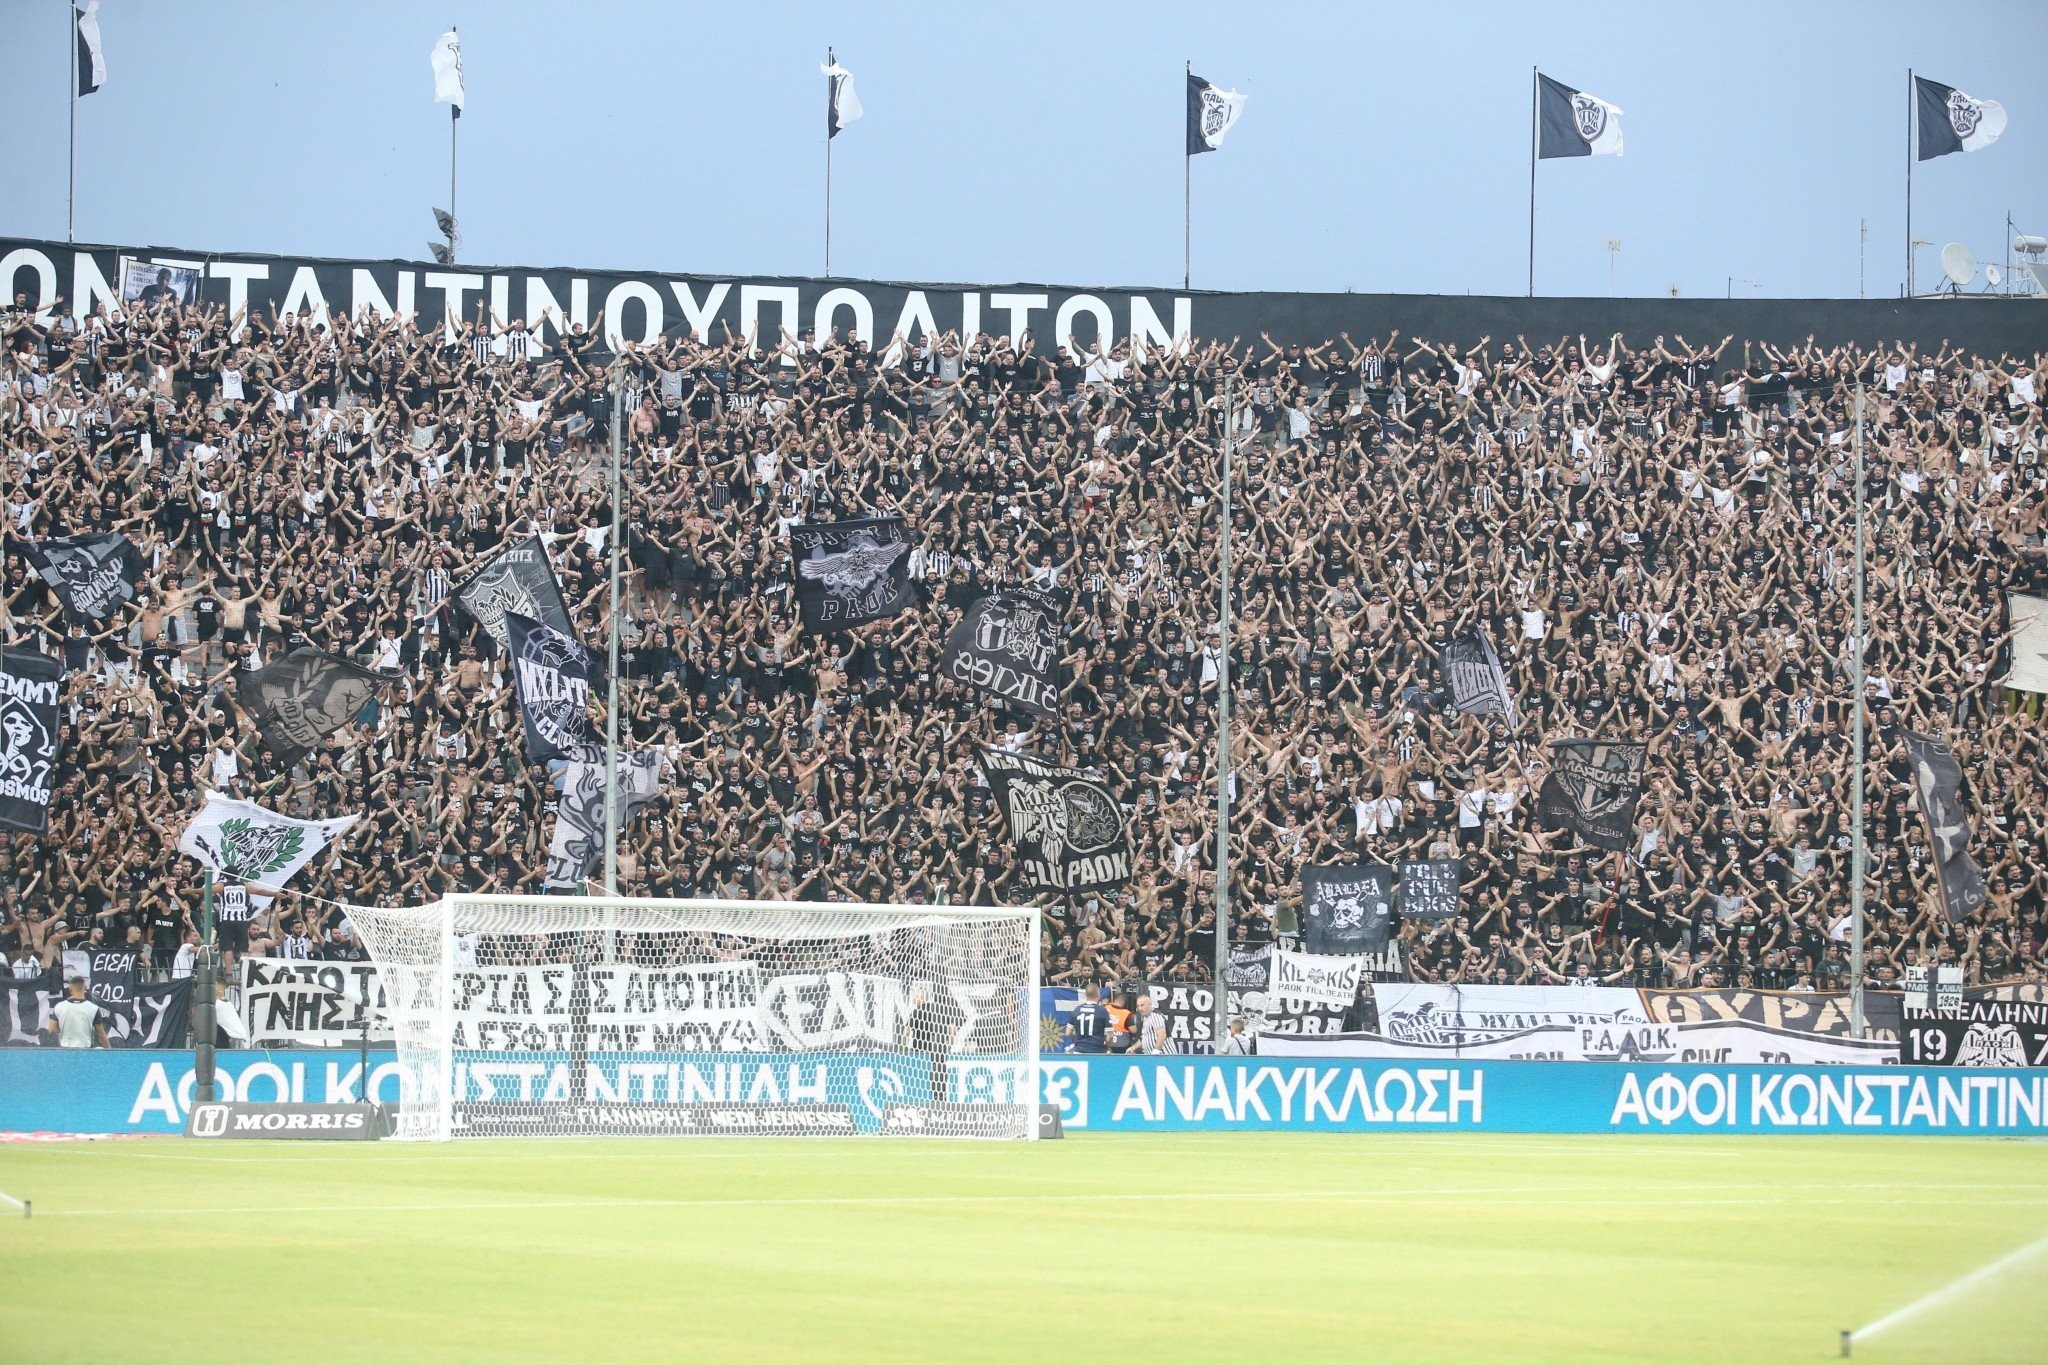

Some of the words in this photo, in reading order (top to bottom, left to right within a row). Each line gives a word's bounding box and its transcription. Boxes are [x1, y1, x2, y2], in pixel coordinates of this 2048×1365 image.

[0, 248, 1193, 366] ΩΝΤΑΝΤΙΝΟΥΠΟΛΙΤΩΝ
[821, 577, 899, 620] PAOK
[1067, 851, 1130, 888] PAOK
[226, 892, 244, 905] 60
[1277, 983, 1302, 994] PAOK
[1305, 985, 1325, 995] TILL
[1325, 989, 1354, 1000] DEATH
[1076, 1013, 1095, 1036] 11
[1909, 1029, 1947, 1061] 19
[1111, 1065, 1484, 1124] ΑΝΑΚΥΚΛΩΣΗ
[1610, 1073, 1737, 1126] ΑΦΟΙ
[234, 1113, 364, 1130] MORRIS
